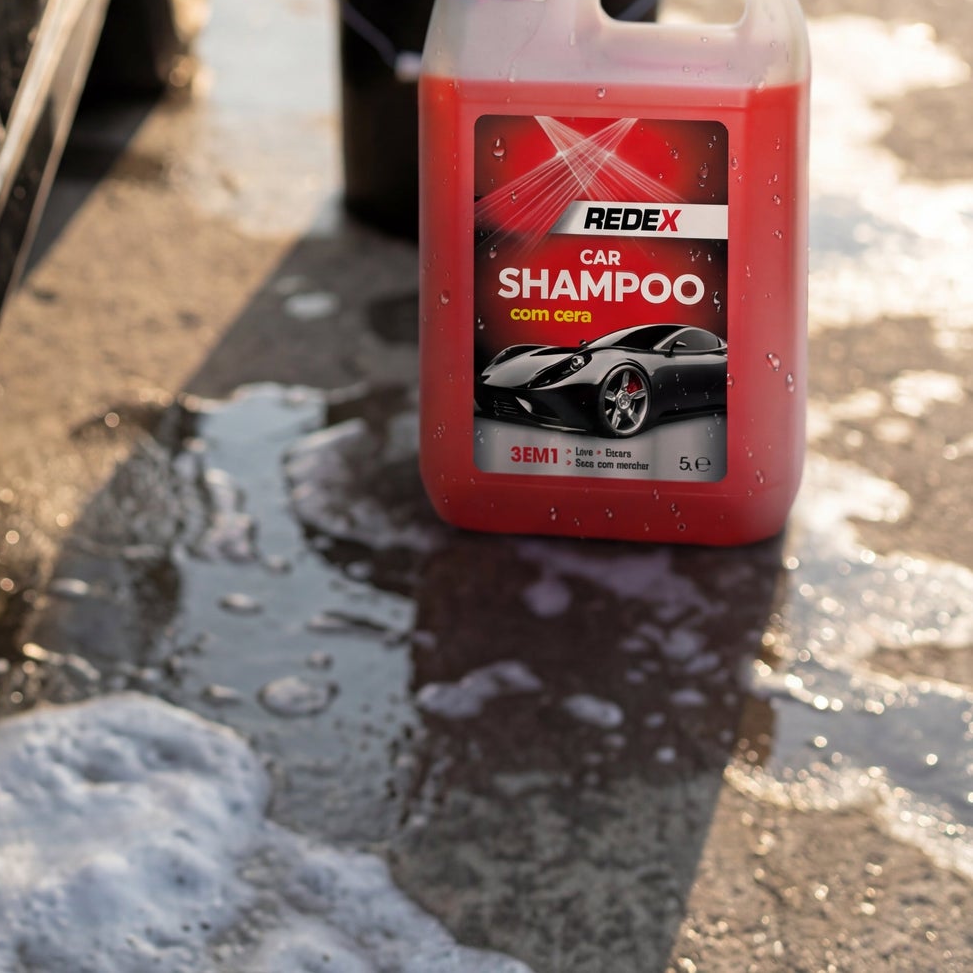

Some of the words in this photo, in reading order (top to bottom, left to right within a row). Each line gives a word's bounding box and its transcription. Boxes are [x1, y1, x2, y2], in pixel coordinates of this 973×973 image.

[583, 206, 682, 232] REDEX
[579, 249, 621, 266] CAR
[497, 267, 706, 306] SHAMPOO
[509, 308, 550, 322] com
[553, 309, 592, 323] cera
[510, 446, 558, 464] 3EM1
